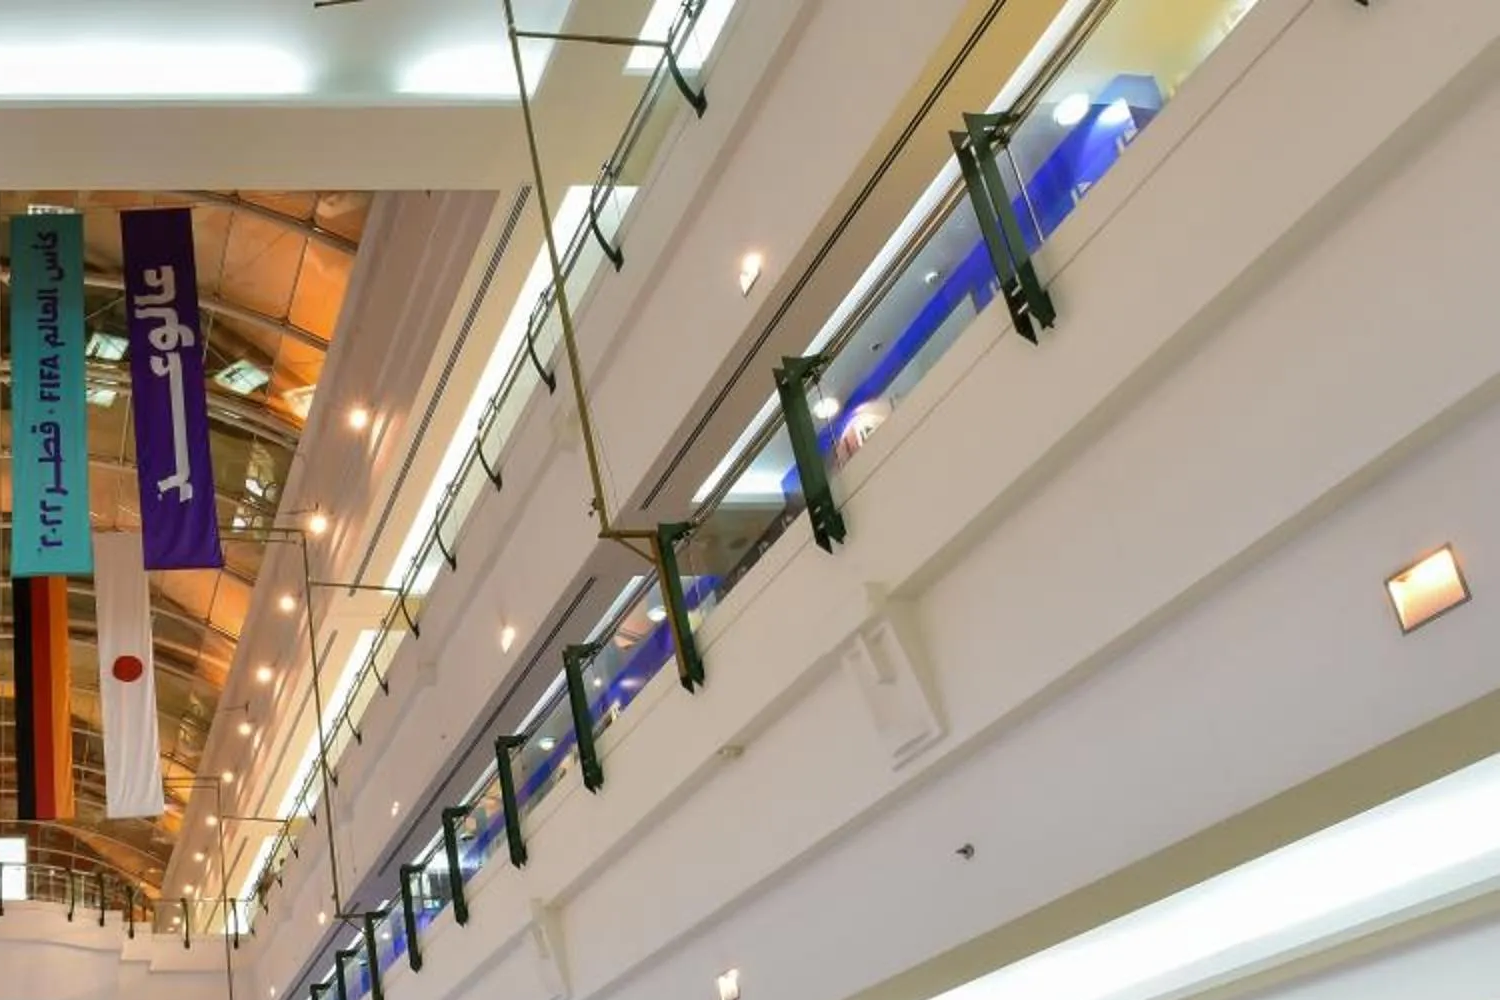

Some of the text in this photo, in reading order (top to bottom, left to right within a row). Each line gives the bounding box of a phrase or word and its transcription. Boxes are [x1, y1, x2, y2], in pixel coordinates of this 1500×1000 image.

[32, 231, 65, 281] كأس
[38, 288, 66, 349] العالم
[39, 354, 61, 403] FIFA
[31, 420, 69, 496] قطر
